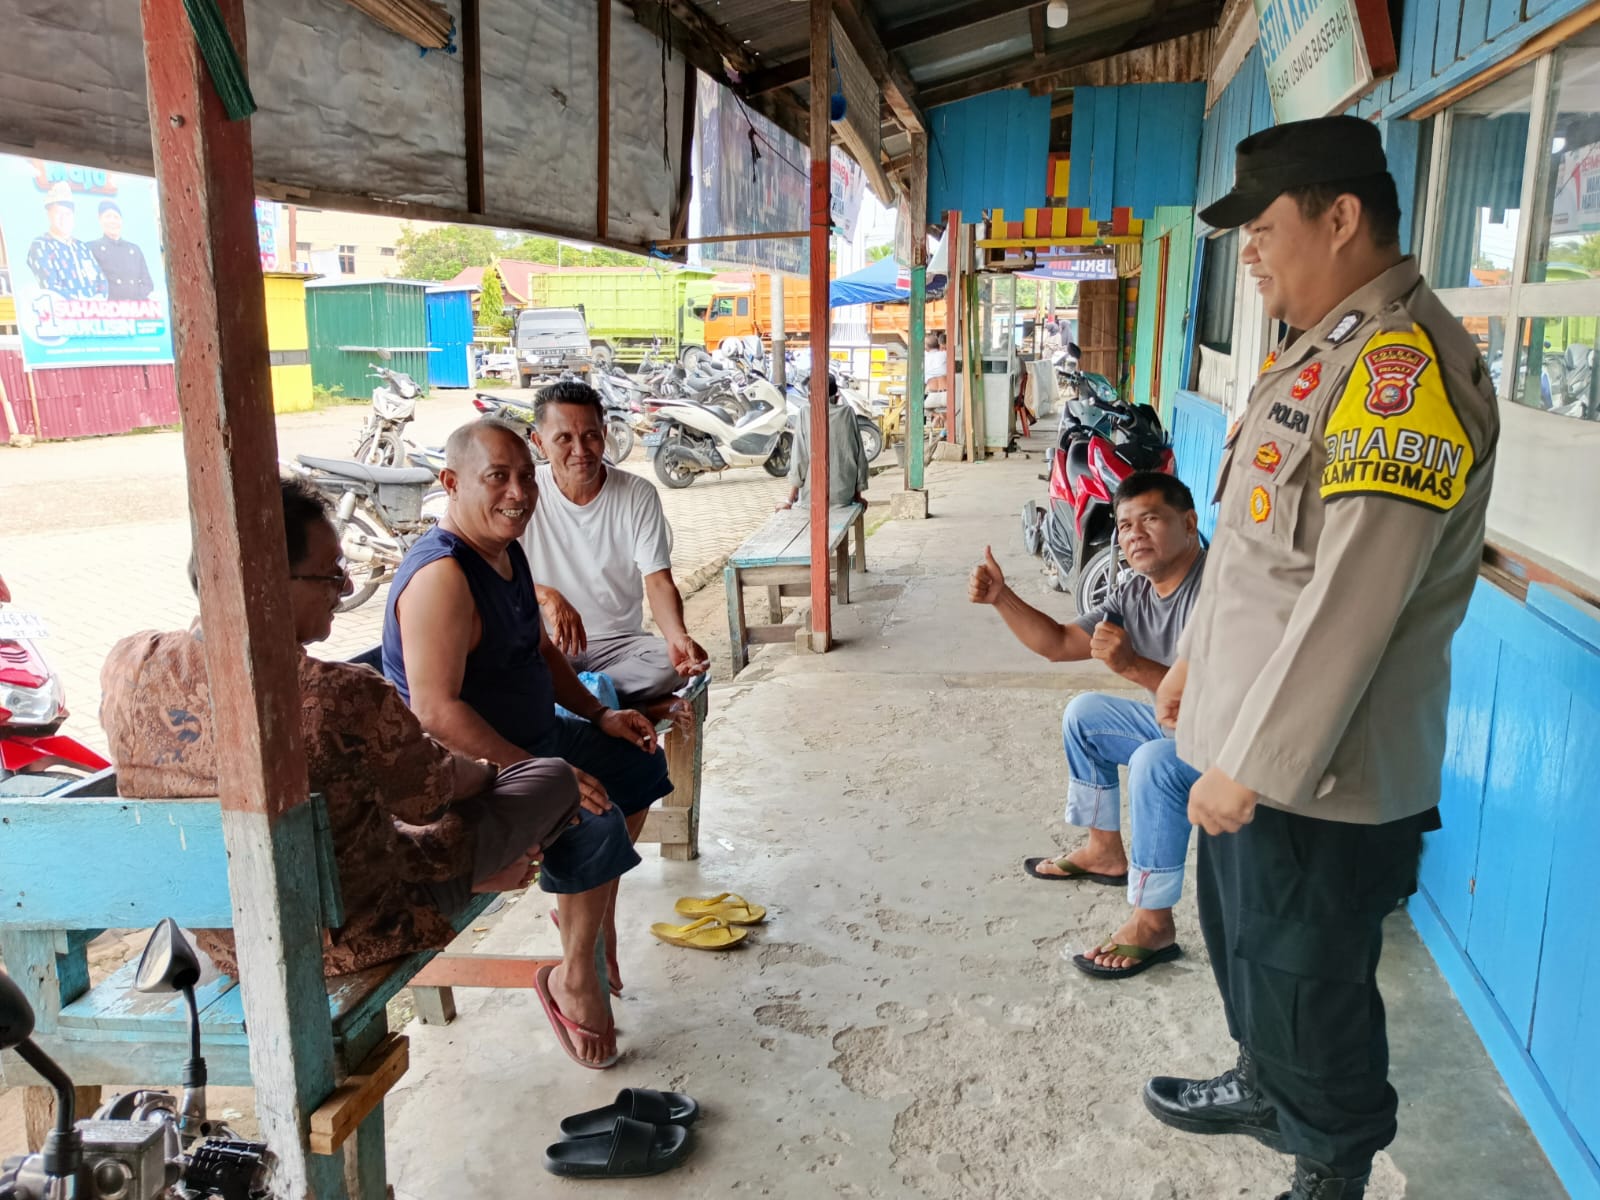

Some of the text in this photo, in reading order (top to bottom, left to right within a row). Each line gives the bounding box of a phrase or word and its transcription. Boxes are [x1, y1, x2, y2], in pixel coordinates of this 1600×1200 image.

[1259, 0, 1291, 68] SETIA
[1270, 7, 1352, 98] PASAR USANG BASERAH
[55, 299, 163, 320] SUHARDIMAN
[1268, 402, 1310, 434] POLRI
